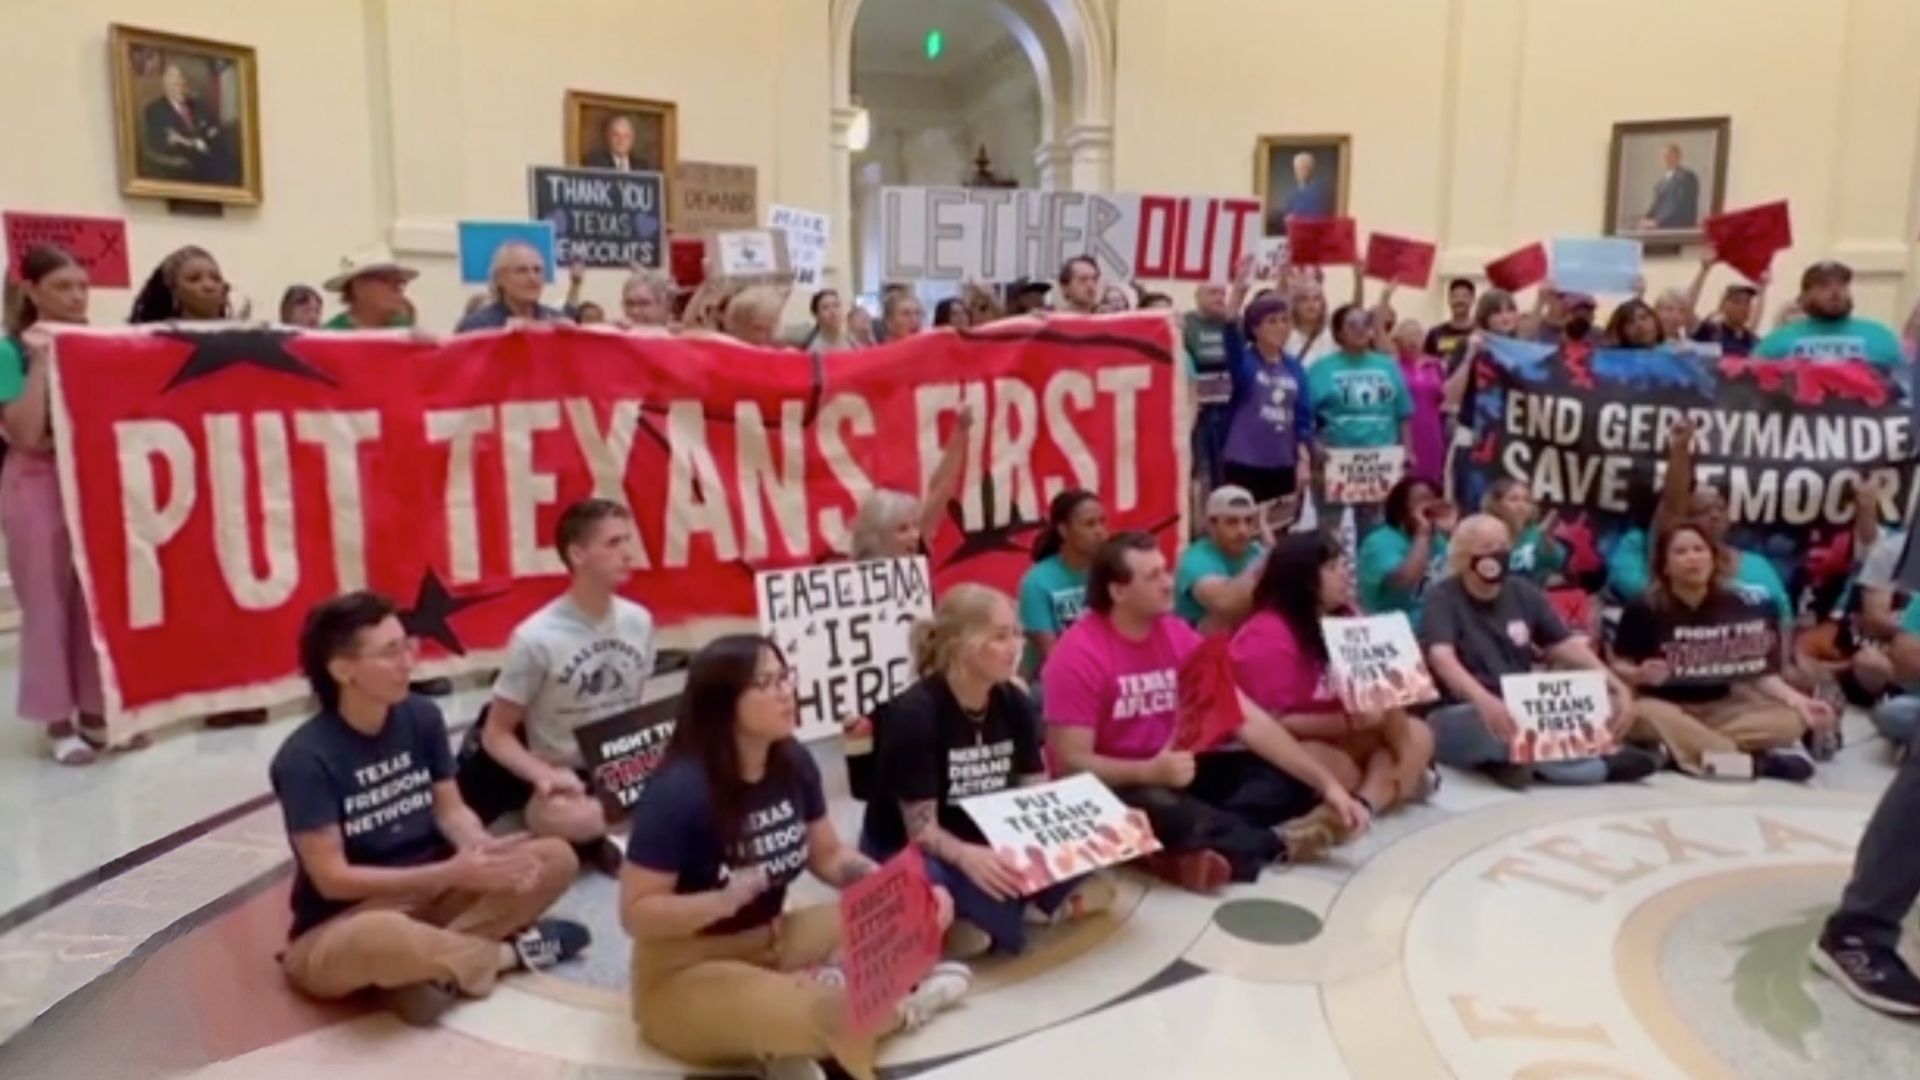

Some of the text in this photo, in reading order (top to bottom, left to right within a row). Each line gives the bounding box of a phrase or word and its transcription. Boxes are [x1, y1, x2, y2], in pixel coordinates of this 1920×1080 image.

[545, 175, 654, 212] THANK YOU
[571, 210, 632, 238] TEXAS
[1134, 194, 1261, 282] OUT
[555, 239, 654, 263] EMOCRATS
[1506, 390, 1582, 449] END
[1503, 441, 1630, 514] SAVE
[114, 365, 1152, 630] PUT TEXANS FIRST
[823, 613, 874, 669] IS
[1674, 625, 1731, 640] FIGHT
[794, 657, 908, 728] HERE
[1116, 669, 1177, 697] TEXAS
[1537, 679, 1572, 697] PUT
[1522, 696, 1595, 715] TEXANS
[1537, 712, 1587, 732] FIRST
[601, 726, 652, 760] FIGHT
[354, 750, 412, 787] TEXAS
[343, 765, 432, 816] FREEDOM
[1013, 790, 1062, 812] PUT
[746, 798, 795, 833] EXAS
[1003, 798, 1103, 834] TEXANS
[1034, 818, 1097, 848] FIRST
